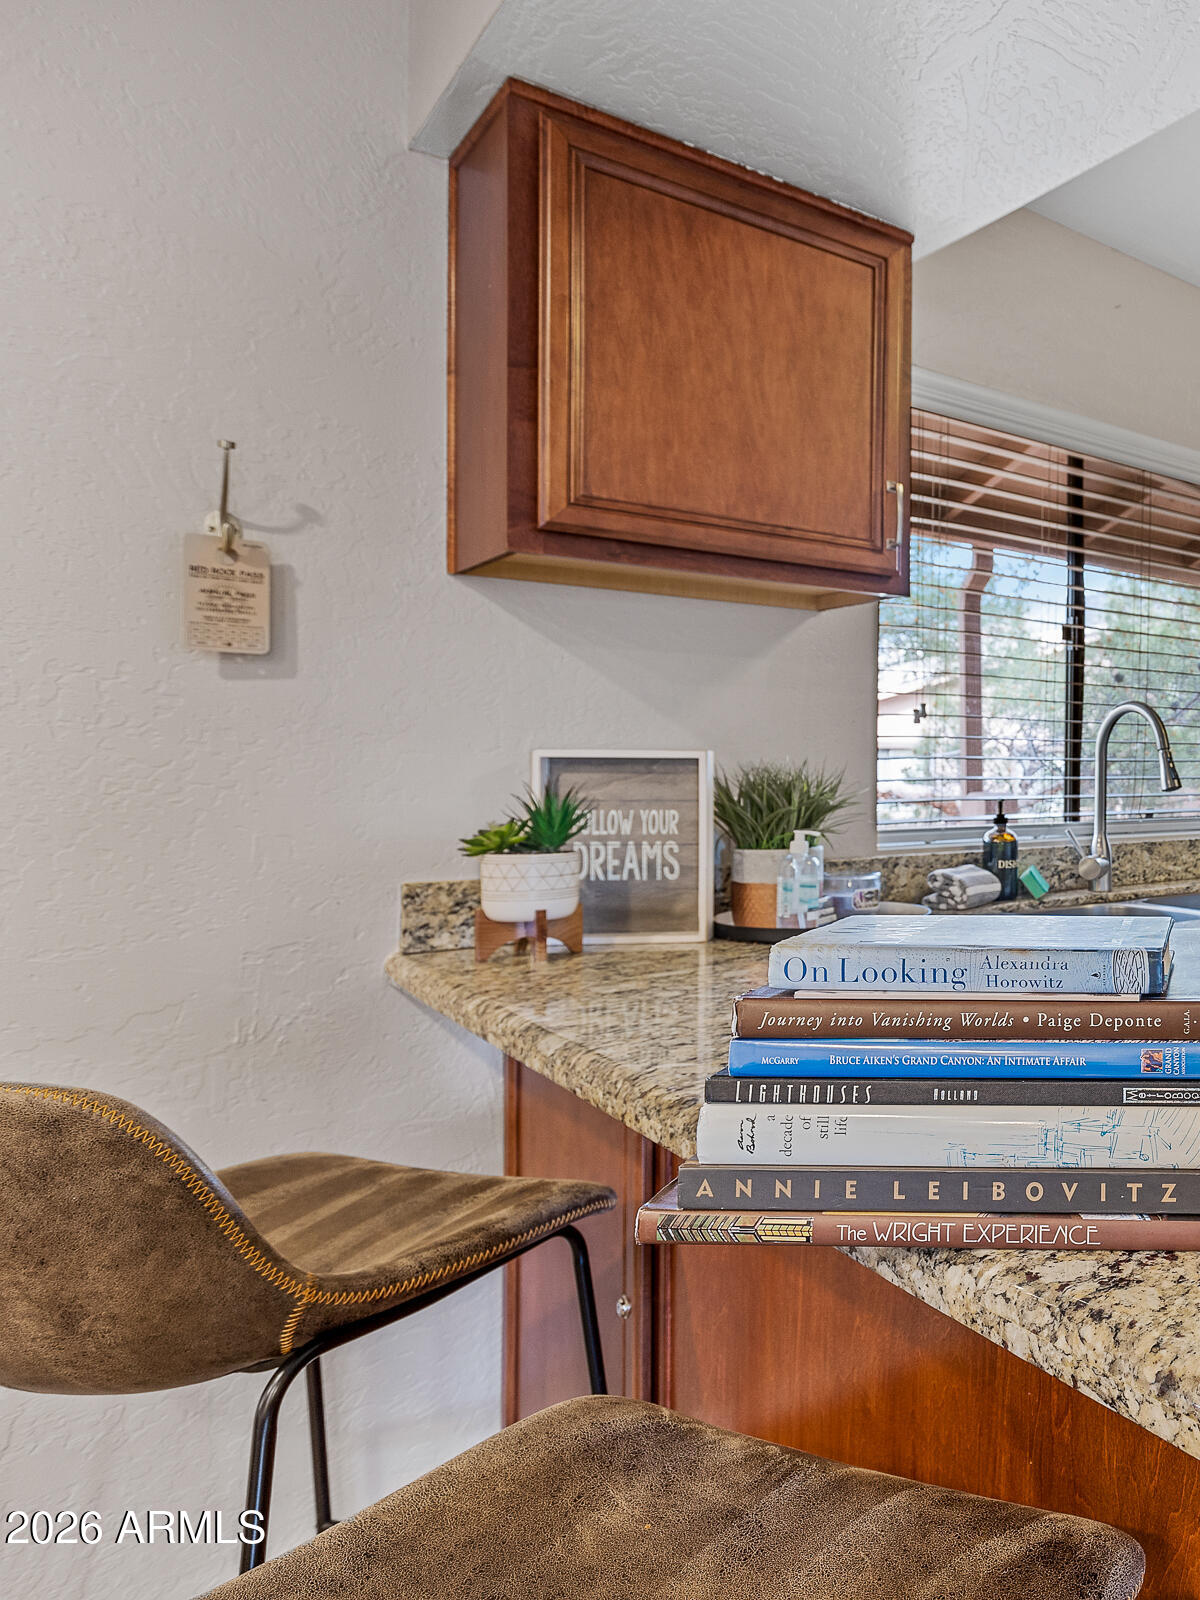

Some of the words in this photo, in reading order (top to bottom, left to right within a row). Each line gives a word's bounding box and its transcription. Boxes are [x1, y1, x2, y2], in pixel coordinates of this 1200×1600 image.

[640, 809, 680, 835] YOUR
[783, 956, 830, 983] On
[838, 957, 968, 991] Looking
[980, 955, 1069, 971] Alexandra
[985, 974, 1064, 989] Horowitz
[758, 1011, 823, 1031] Journey
[830, 1012, 863, 1027] into
[872, 1012, 953, 1031] Vanishing
[960, 1012, 1015, 1027] Worlds
[1037, 1013, 1082, 1031] Paige
[1089, 1013, 1162, 1031] Deponte
[829, 1054, 861, 1065] BRUCE
[863, 1054, 900, 1065] AIKEN'S
[902, 1055, 938, 1066] GRAND
[940, 1055, 984, 1066] CANYON:
[986, 1056, 1001, 1066] AN
[1004, 1055, 1051, 1067] INTIMATE
[1053, 1055, 1087, 1067] AFFAIR
[735, 1080, 872, 1104] LIGHTHOUSES
[933, 1088, 979, 1101] HOLLAND
[799, 1114, 812, 1130] of
[817, 1115, 830, 1139] still
[834, 1116, 848, 1136] life
[779, 1114, 794, 1157] decade
[695, 1178, 857, 1199] ANNIE
[893, 1180, 1177, 1203] LEIBOVITZ
[836, 1224, 867, 1243] The
[872, 1222, 956, 1243] WRIGHT
[963, 1223, 1101, 1245] EXPERIENCE
